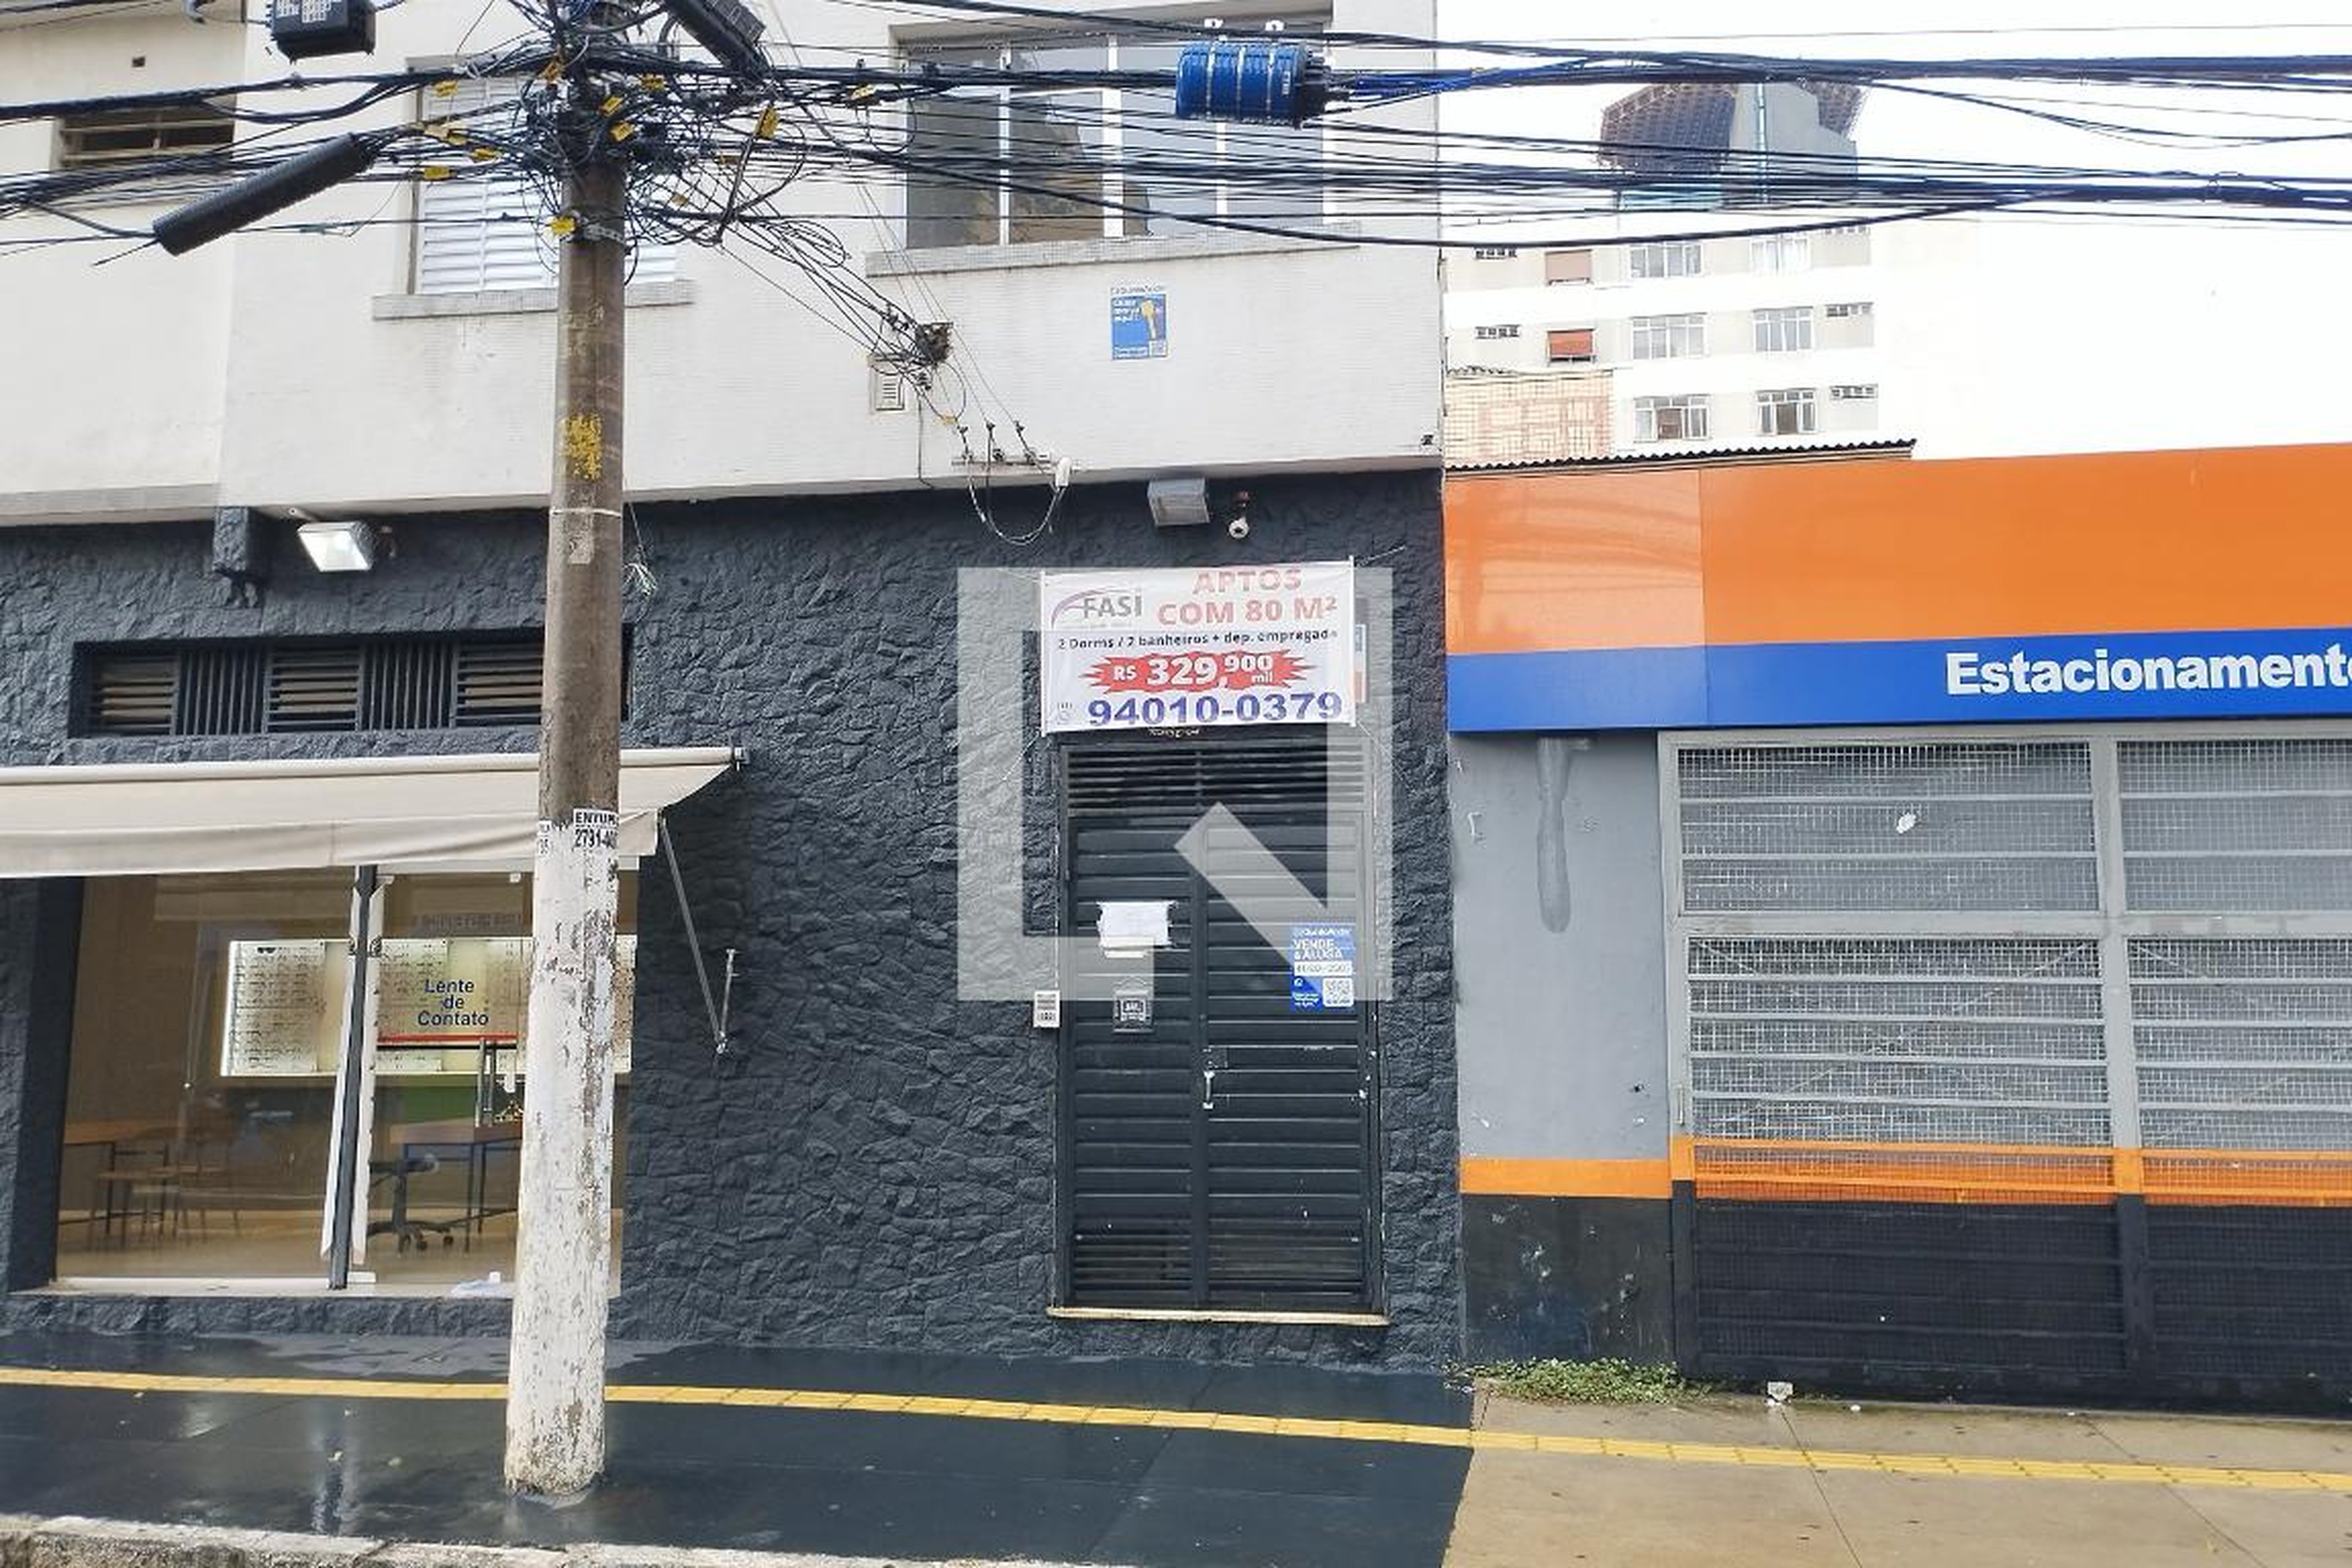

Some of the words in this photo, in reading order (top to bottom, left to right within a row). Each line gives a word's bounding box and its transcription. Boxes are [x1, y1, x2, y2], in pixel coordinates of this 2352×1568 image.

[1193, 568, 1302, 594] APTOS
[1084, 595, 1142, 619] FASI
[1158, 603, 1235, 625] COM
[1245, 600, 1283, 621] 80
[1294, 596, 1338, 620] M²
[1069, 637, 1114, 649] Dorms
[1128, 636, 1135, 647] 2
[1139, 633, 1208, 647] banheiros
[1224, 632, 1254, 645] dep.
[1251, 673, 1273, 684] mil
[1947, 643, 2352, 695] Estacionament
[1088, 692, 1342, 726] 94010-0379
[424, 979, 475, 993] Lente
[443, 994, 464, 1009] de
[418, 1011, 489, 1026] Contato
